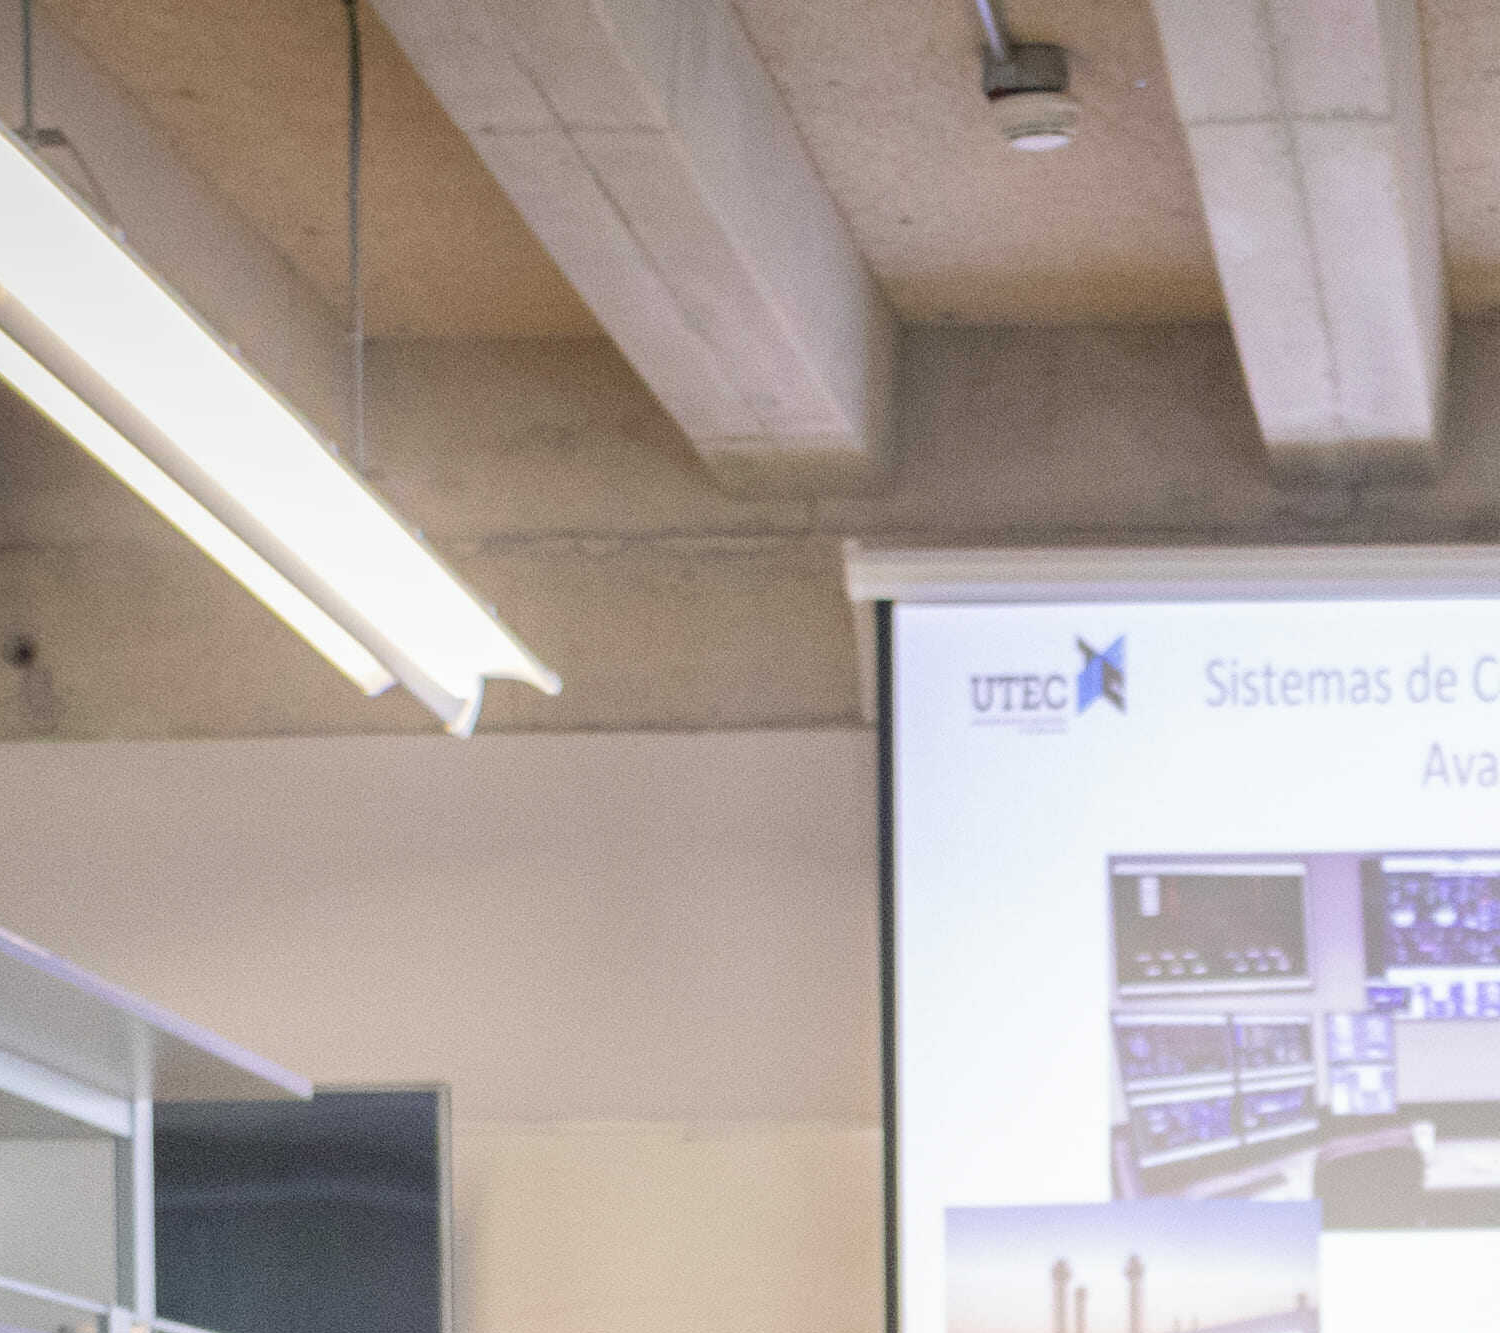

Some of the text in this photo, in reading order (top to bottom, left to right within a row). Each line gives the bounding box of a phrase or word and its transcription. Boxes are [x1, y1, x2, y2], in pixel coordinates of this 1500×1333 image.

[970, 673, 1068, 713] UTEC
[1204, 656, 1394, 707] Sistemas
[1405, 652, 1459, 704] de
